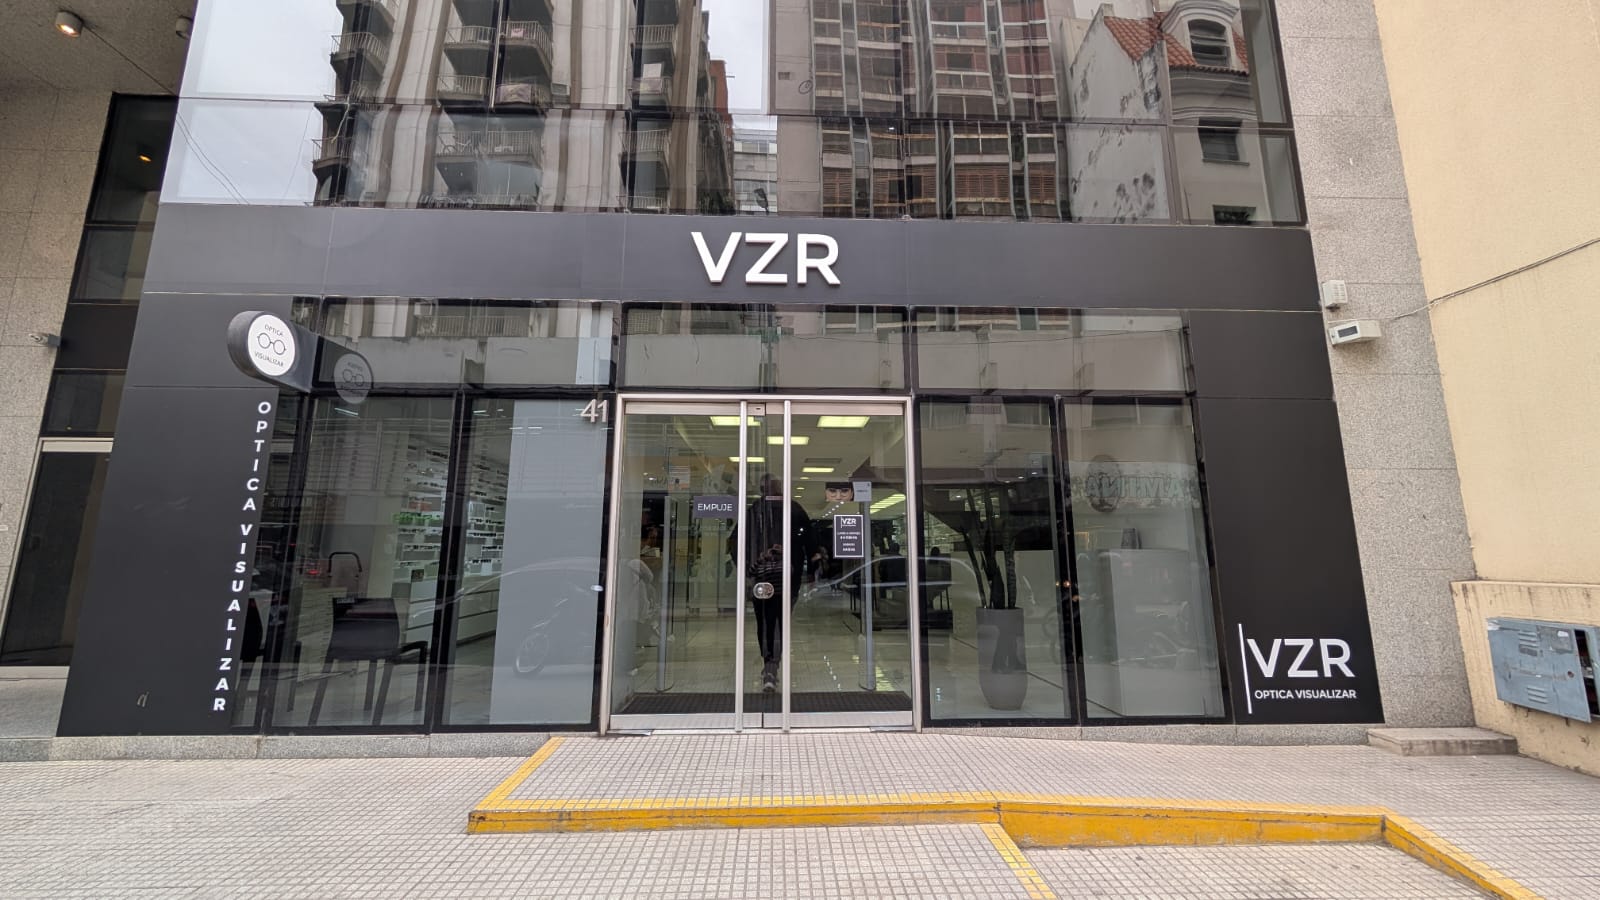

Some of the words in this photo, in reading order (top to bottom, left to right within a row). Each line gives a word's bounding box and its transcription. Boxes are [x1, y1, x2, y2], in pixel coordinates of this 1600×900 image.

[690, 231, 841, 285] VZR
[264, 323, 284, 337] OPTICA
[254, 350, 285, 367] VISUALIZAR
[580, 399, 608, 423] 41
[242, 401, 272, 511] OPTICA
[697, 503, 733, 512] EMPUJE
[213, 523, 253, 711] VISUALIZAR
[1246, 638, 1356, 678] VZR
[1254, 689, 1294, 700] OPTICA
[1295, 689, 1357, 700] VISUALIZAR
